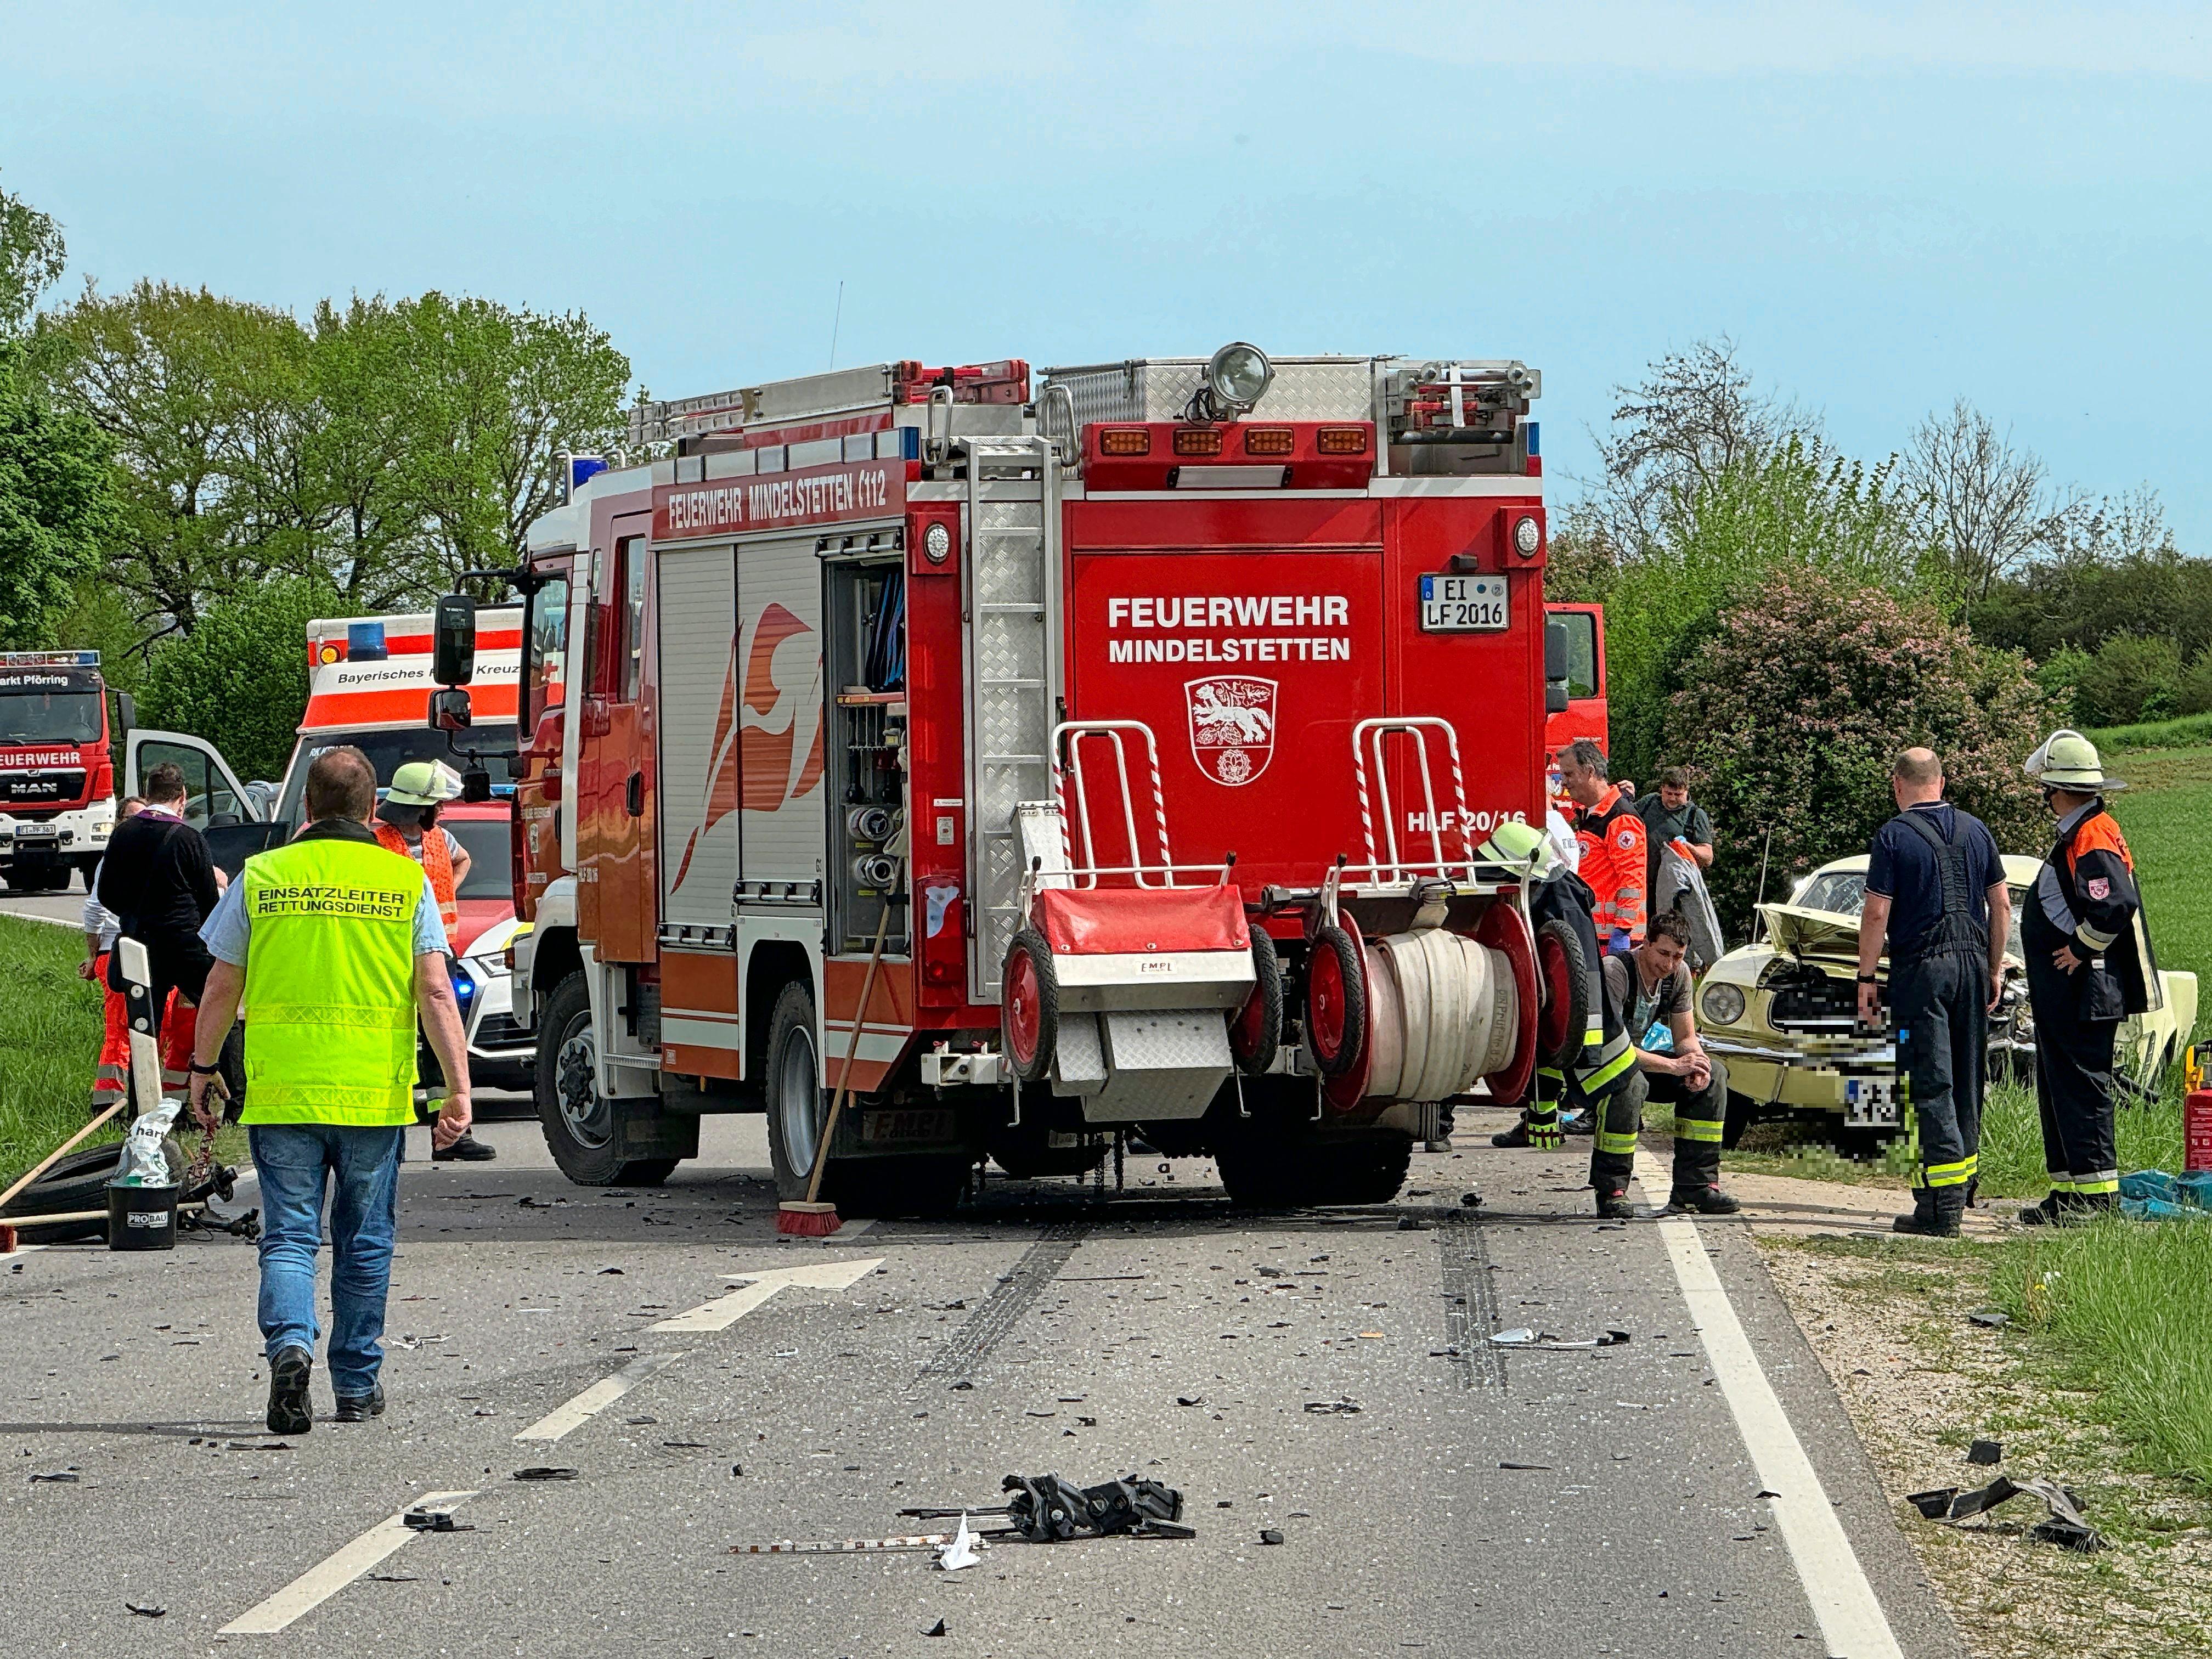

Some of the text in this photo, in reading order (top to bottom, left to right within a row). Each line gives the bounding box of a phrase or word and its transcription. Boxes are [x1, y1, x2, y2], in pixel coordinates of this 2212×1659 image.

[669, 469, 885, 529] FEUERWEHR MINDELSTETTEN 112
[1445, 579, 1466, 600] EI
[1109, 596, 1348, 628] FEUERWEHR
[1427, 603, 1502, 625] LF 2016
[1109, 638, 1350, 662] MINDELSTETTEN
[0, 675, 68, 687] arkt Pförring
[338, 669, 424, 684] Bayerisches
[476, 665, 520, 675] Kreuz
[0, 752, 81, 766] EUERWEHR
[10, 783, 57, 794] MAN
[1408, 810, 1526, 832] HLF 20/16
[258, 887, 404, 905] EINSATZLEITER
[258, 900, 404, 917] RETTUNGSDIENST
[1141, 962, 1172, 972] EMPL
